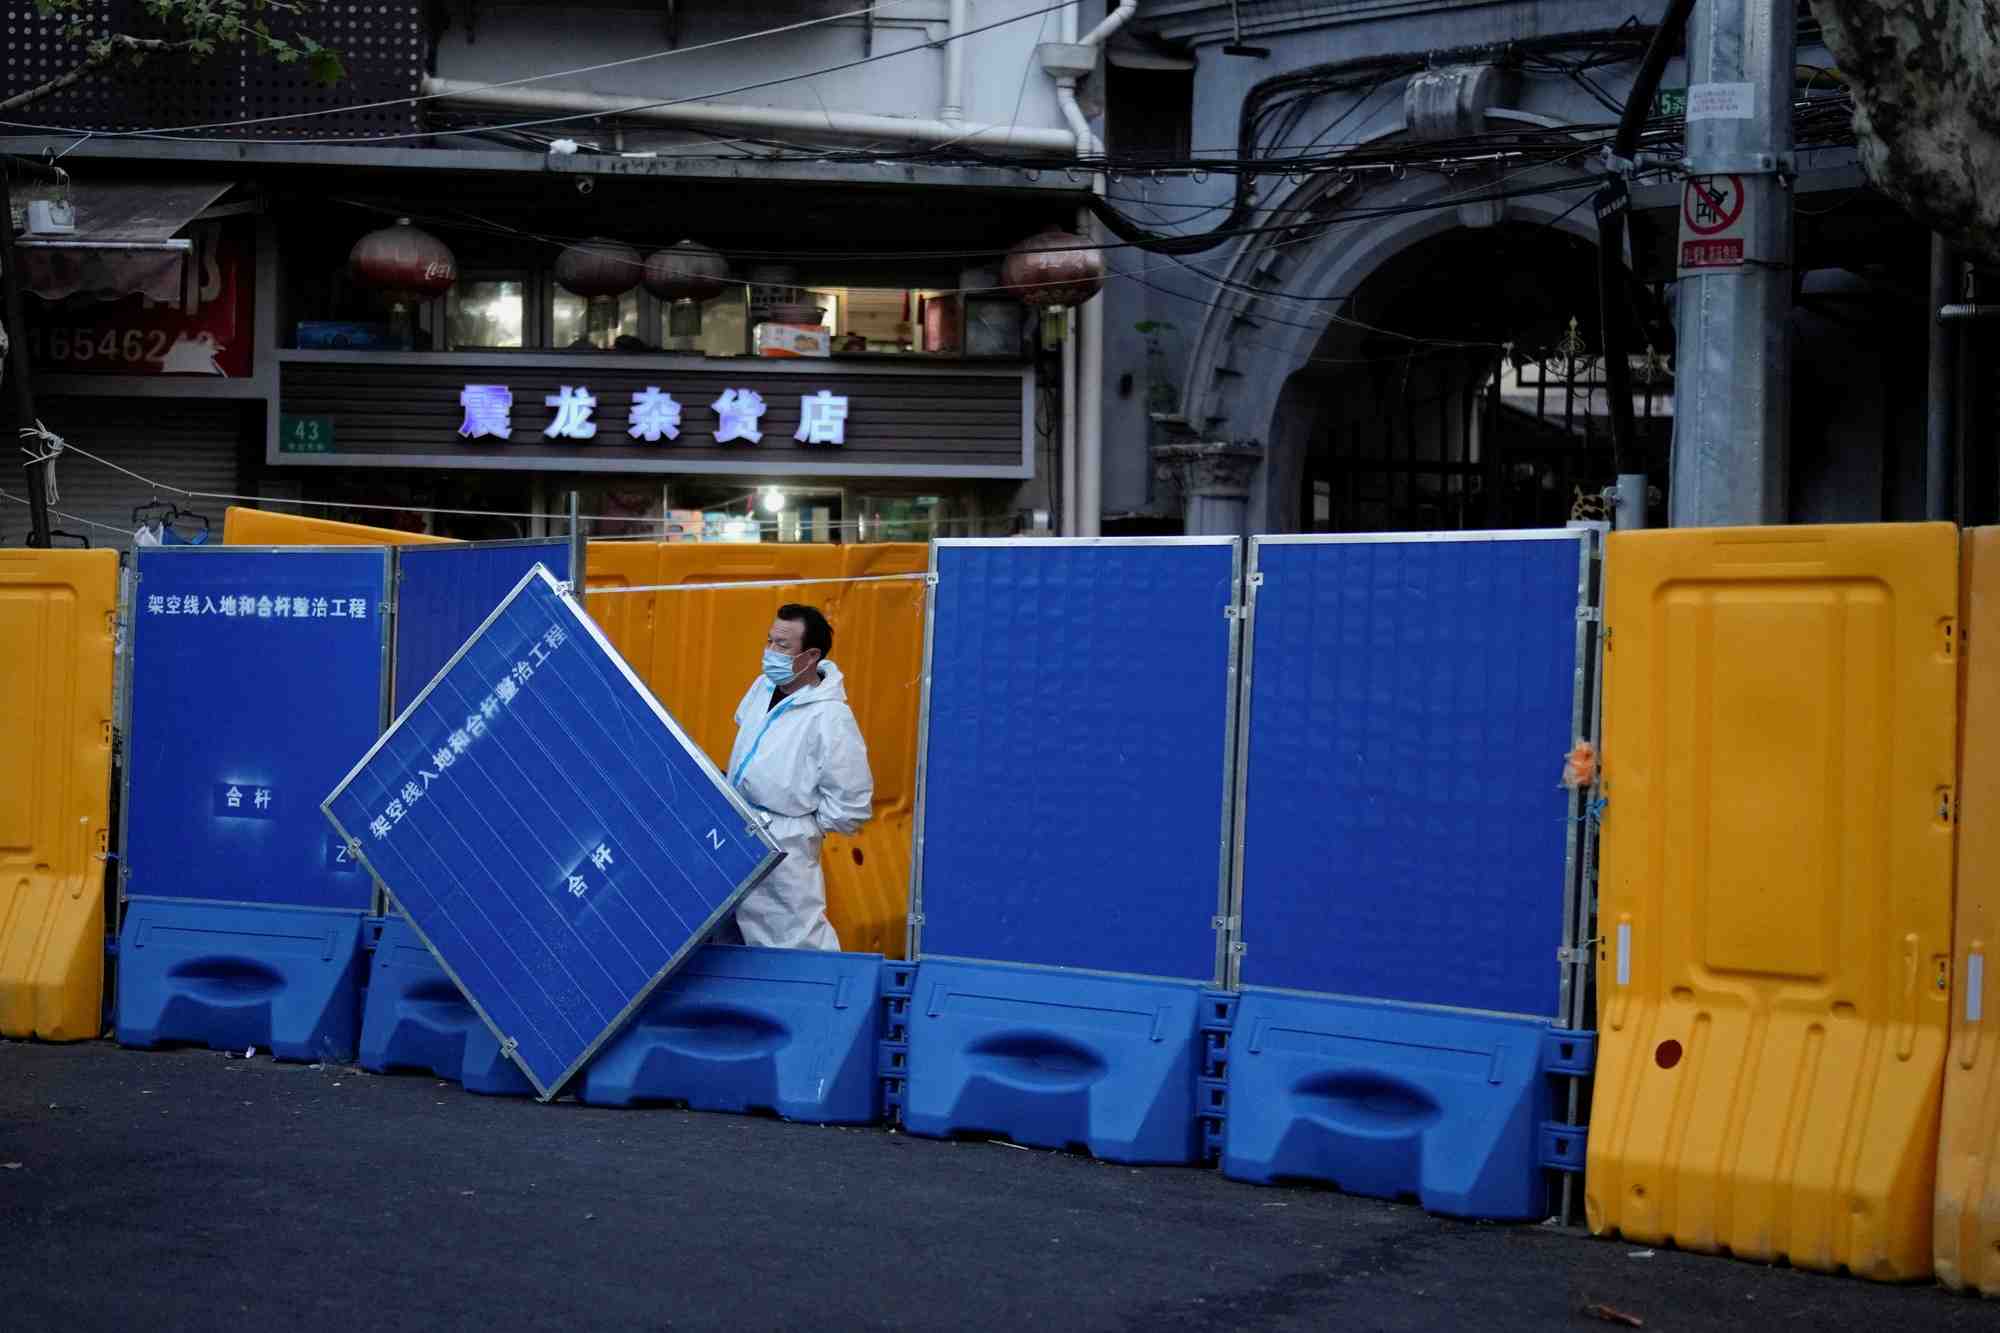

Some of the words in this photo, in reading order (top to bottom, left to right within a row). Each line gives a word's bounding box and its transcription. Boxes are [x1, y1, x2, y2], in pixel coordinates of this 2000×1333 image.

[295, 420, 320, 441] 43
[148, 594, 367, 619] 架空线入地和合杆整治工程
[369, 623, 568, 840] 架空线入地和合杆整治工程
[226, 785, 272, 809] 合杆
[567, 843, 614, 899] 合杆
